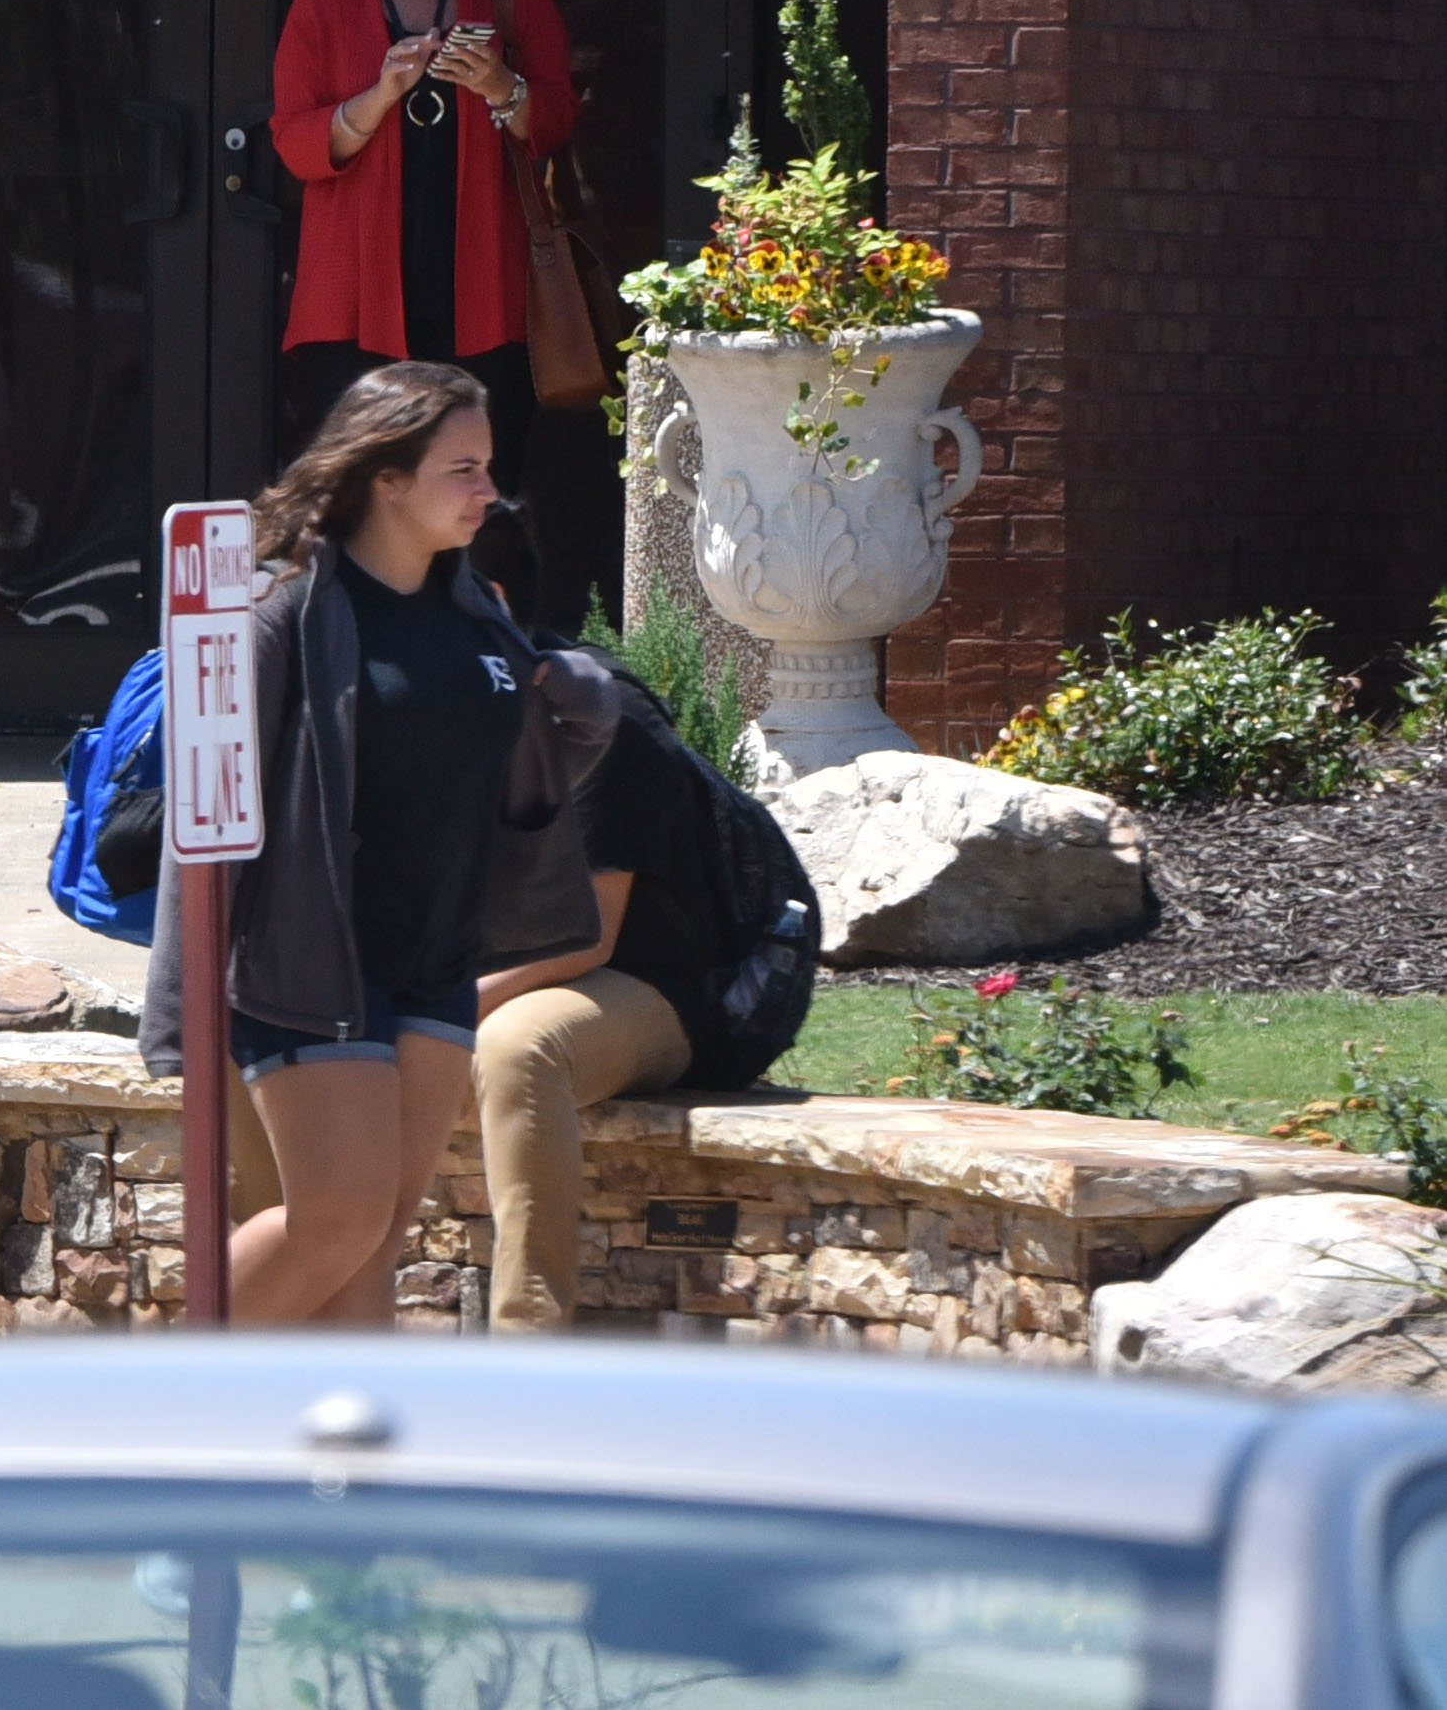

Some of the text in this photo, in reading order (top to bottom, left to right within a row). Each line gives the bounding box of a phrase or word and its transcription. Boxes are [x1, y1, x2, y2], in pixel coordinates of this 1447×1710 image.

[174, 543, 201, 596] NO
[197, 633, 238, 717] FIRE
[191, 741, 248, 826] LANE
